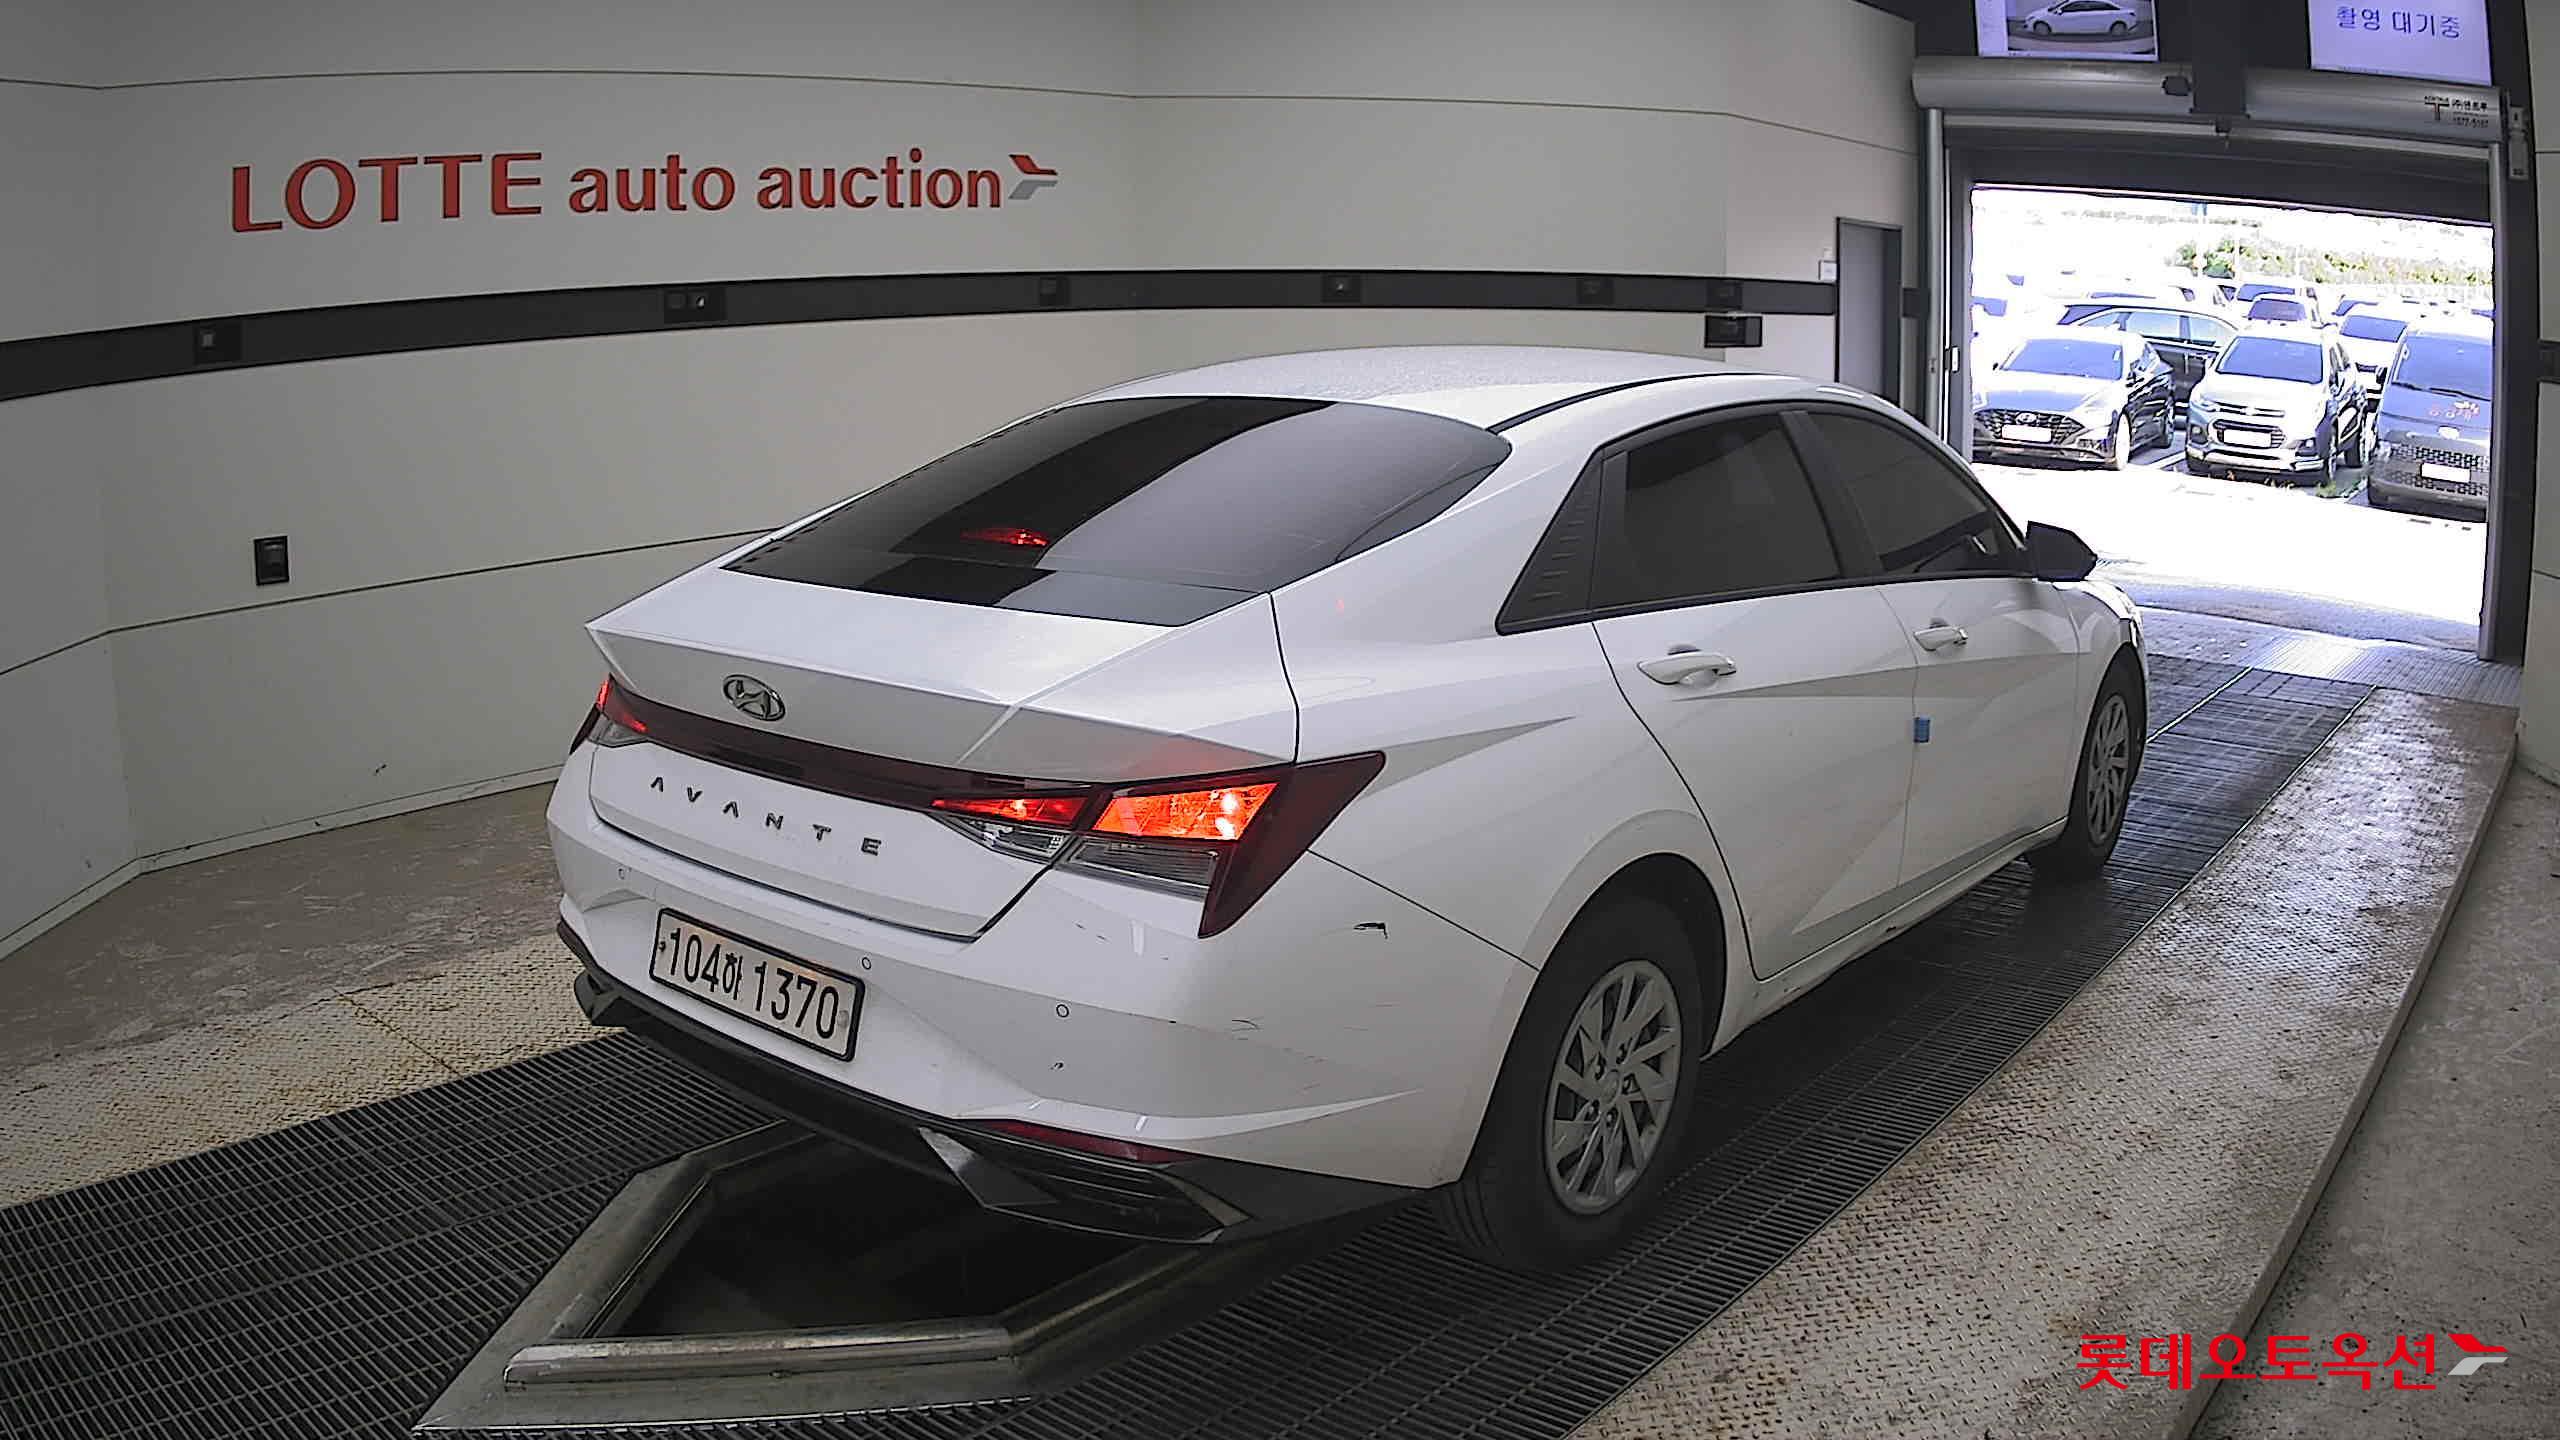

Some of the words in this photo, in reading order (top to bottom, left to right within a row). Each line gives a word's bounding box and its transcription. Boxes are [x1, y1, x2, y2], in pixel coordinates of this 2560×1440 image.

[2337, 6, 2381, 31] 촬영
[2392, 11, 2460, 39] 대기중
[233, 153, 541, 232] LOTTE
[568, 154, 736, 213] auto
[757, 148, 1001, 209] auction
[650, 776, 882, 856] AVANTE
[670, 927, 743, 1001] 104하
[754, 960, 840, 1039] 1370
